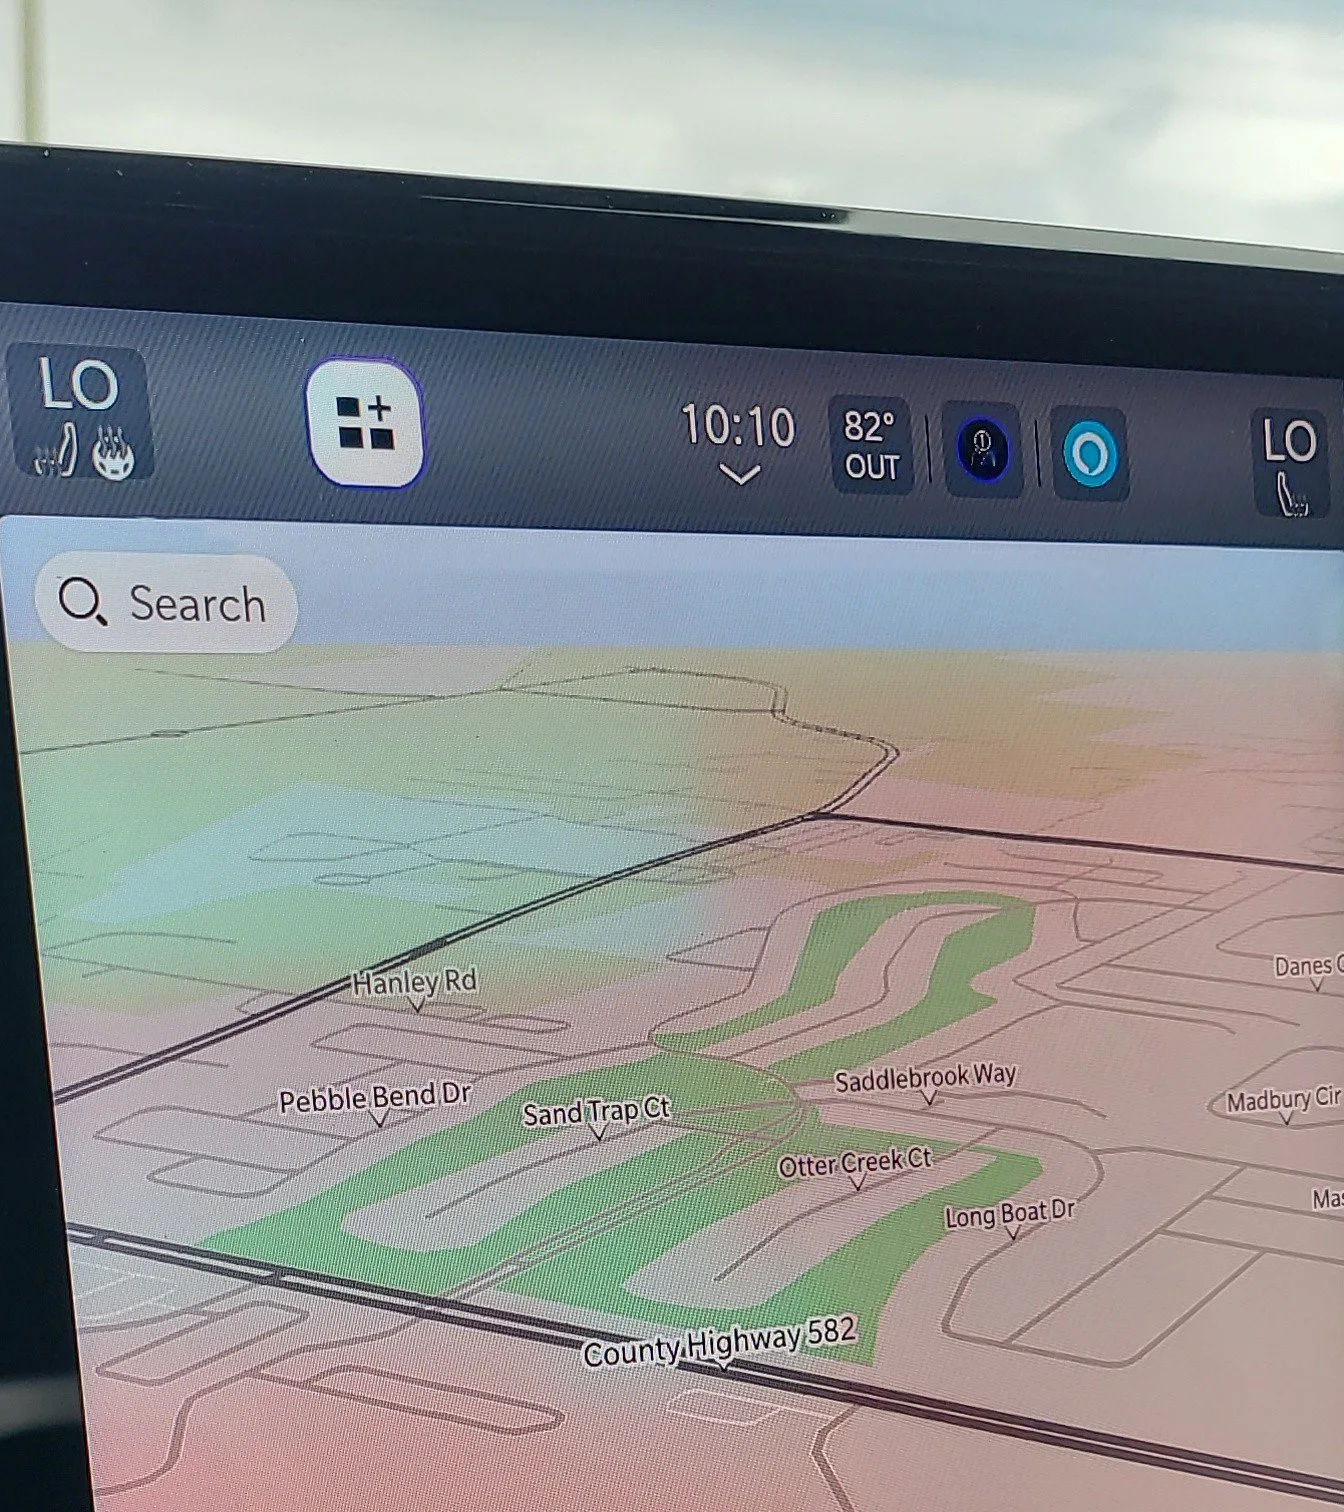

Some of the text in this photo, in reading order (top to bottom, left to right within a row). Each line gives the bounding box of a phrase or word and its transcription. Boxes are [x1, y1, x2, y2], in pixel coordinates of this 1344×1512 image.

[38, 355, 120, 411] LO
[681, 402, 796, 449] 10:10
[842, 410, 895, 442] 82°
[1263, 417, 1317, 463] LO
[844, 453, 900, 482] OUT
[129, 582, 267, 624] Search
[352, 967, 477, 998] Hanley Rd
[1275, 956, 1333, 977] Danes
[834, 1062, 1017, 1093] Saddlebrook Way
[280, 1081, 472, 1114] Pebble Bend Dr
[523, 1095, 670, 1127] Sand Trap Ct
[1227, 1085, 1342, 1113] Madbury Cir
[778, 1146, 933, 1179] Otter Creek Ct
[945, 1198, 1076, 1230] Long Boat Dr
[584, 1316, 857, 1368] County Highway 582
